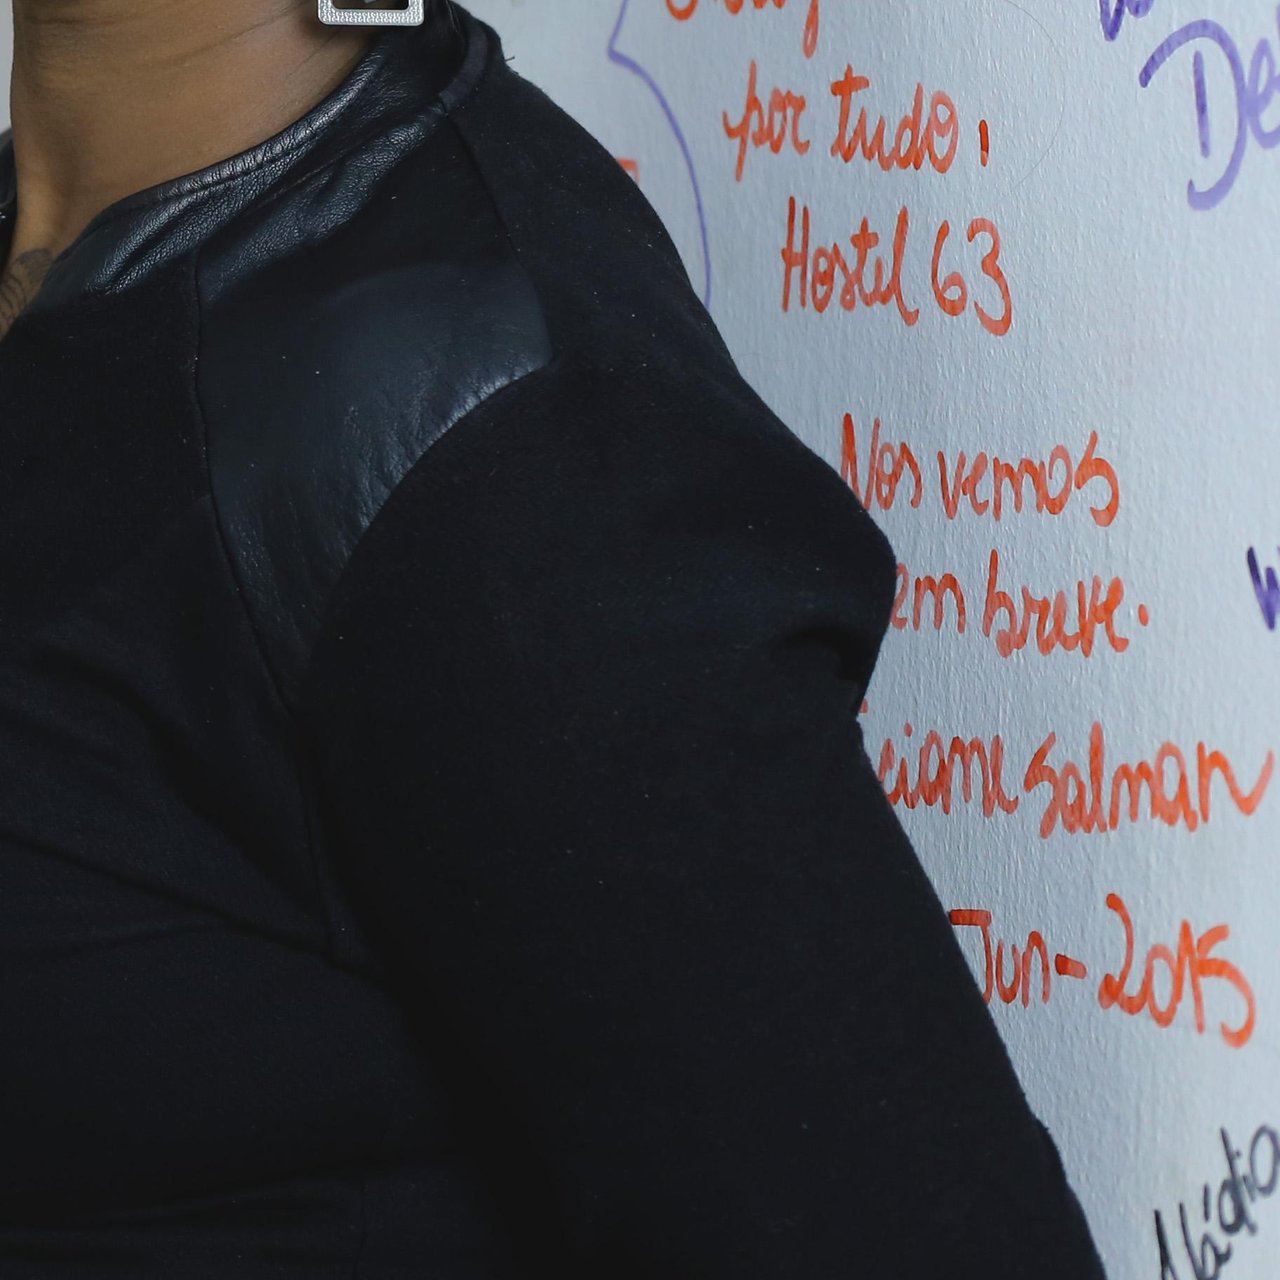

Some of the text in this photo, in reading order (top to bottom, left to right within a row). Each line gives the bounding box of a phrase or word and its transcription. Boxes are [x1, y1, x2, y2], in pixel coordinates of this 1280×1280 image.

[722, 61, 810, 181] por
[1139, 4, 1280, 211] De
[781, 196, 1013, 337] Hostel 63
[841, 412, 1120, 528] Nos vemos
[890, 563, 966, 634] em
